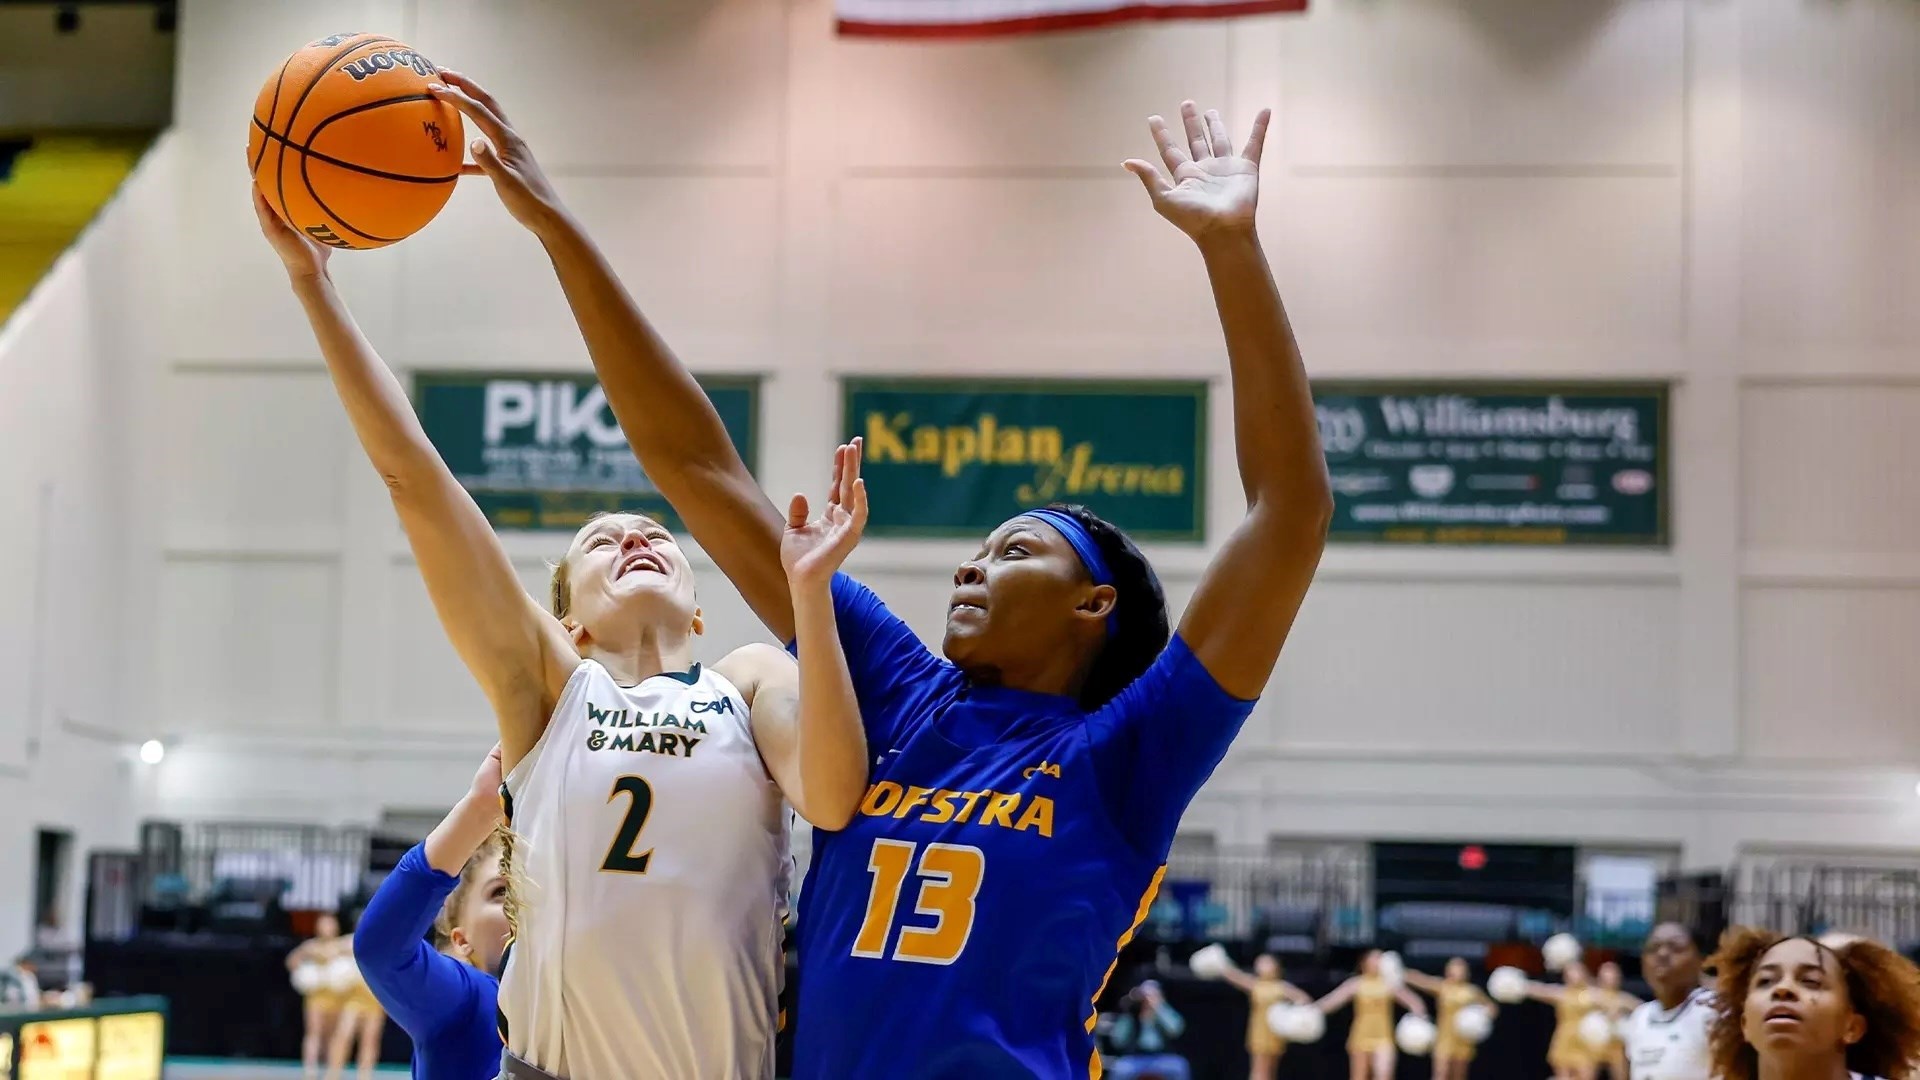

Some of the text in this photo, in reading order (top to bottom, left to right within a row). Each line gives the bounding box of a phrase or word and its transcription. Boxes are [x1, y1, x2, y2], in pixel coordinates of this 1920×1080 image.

[343, 51, 437, 81] ilson
[866, 411, 1063, 477] Kaplan
[1379, 395, 1638, 444] Williamsburg
[1015, 442, 1184, 504] Arena
[587, 702, 709, 734] WILLIAM
[690, 696, 734, 715] CAA
[598, 774, 655, 875] 2
[858, 781, 1055, 838] OFSTRA
[850, 838, 985, 966] 13
